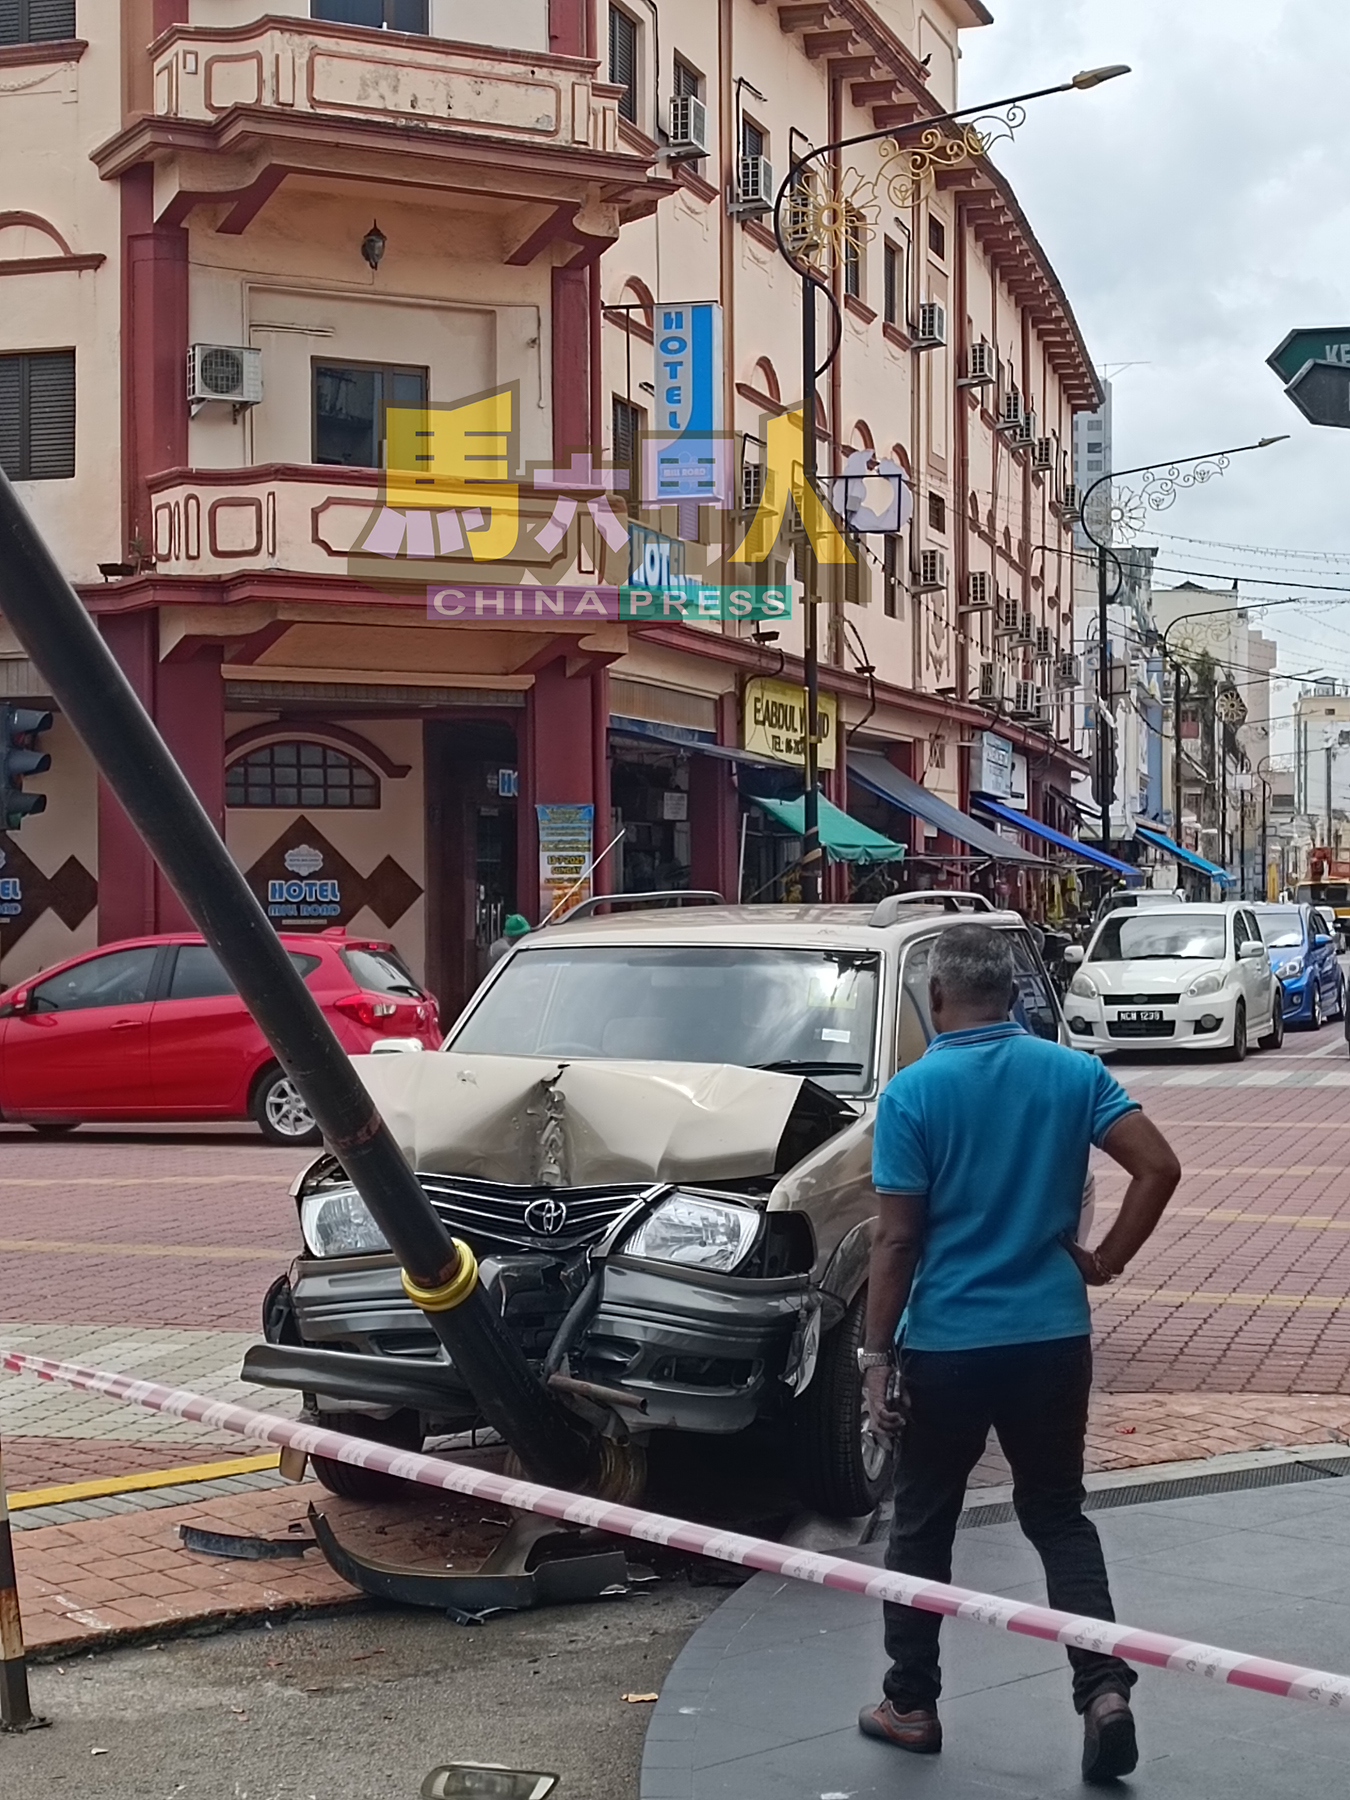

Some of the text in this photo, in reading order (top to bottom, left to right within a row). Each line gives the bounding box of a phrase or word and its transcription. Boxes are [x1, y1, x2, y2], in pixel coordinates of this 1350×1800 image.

[660, 311, 687, 430] HOTEL
[268, 880, 340, 902] HOTEL
[268, 904, 341, 916] MILL ROAD
